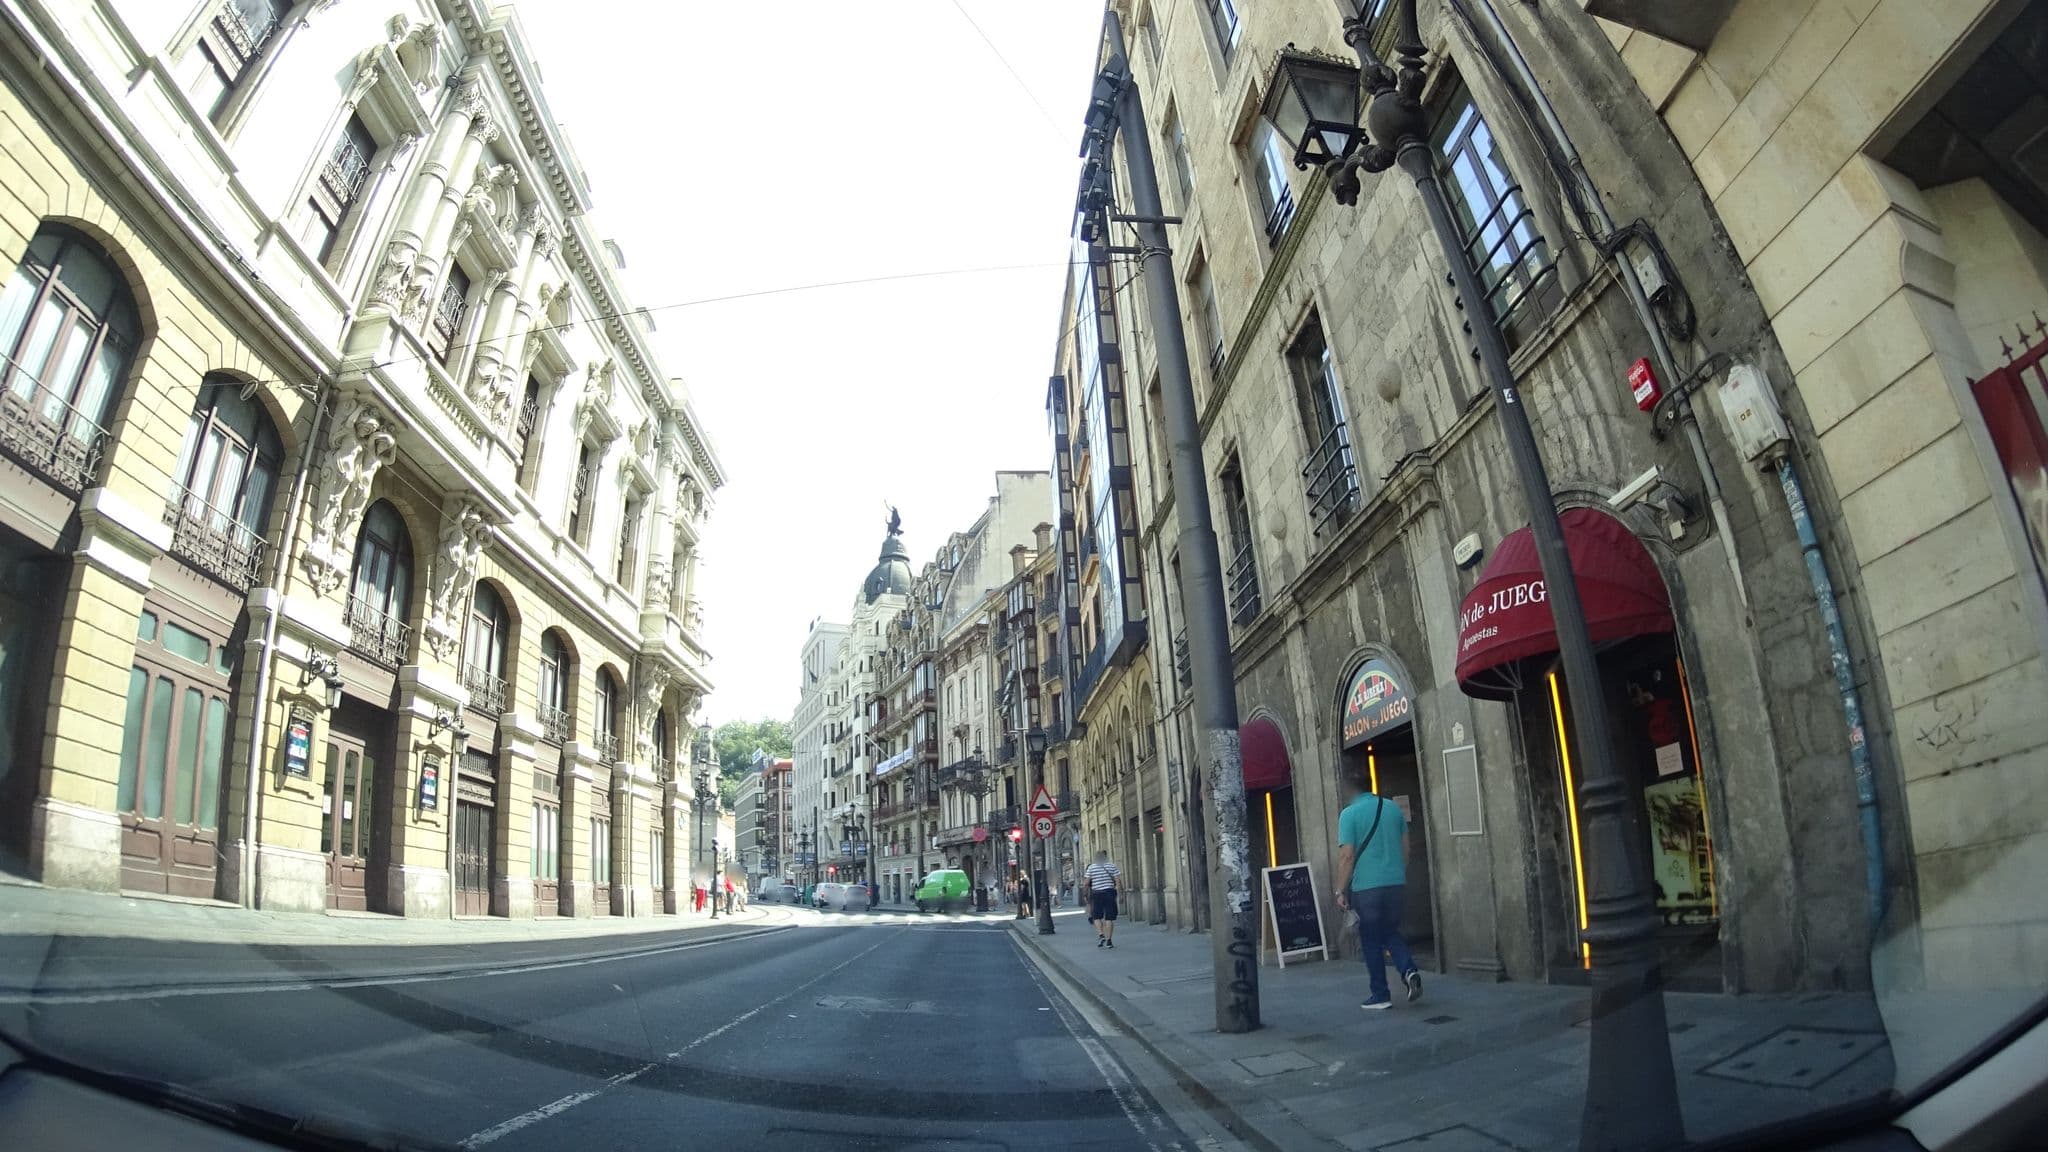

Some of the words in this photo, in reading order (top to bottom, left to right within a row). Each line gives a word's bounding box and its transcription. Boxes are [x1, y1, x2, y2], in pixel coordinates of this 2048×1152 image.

[1471, 602, 1484, 623] de
[1488, 580, 1547, 614] JUEG
[1462, 626, 1498, 651] Apuestas
[1344, 715, 1370, 741] SALON
[1380, 696, 1408, 724] JUEGO
[1037, 822, 1051, 831] 30
